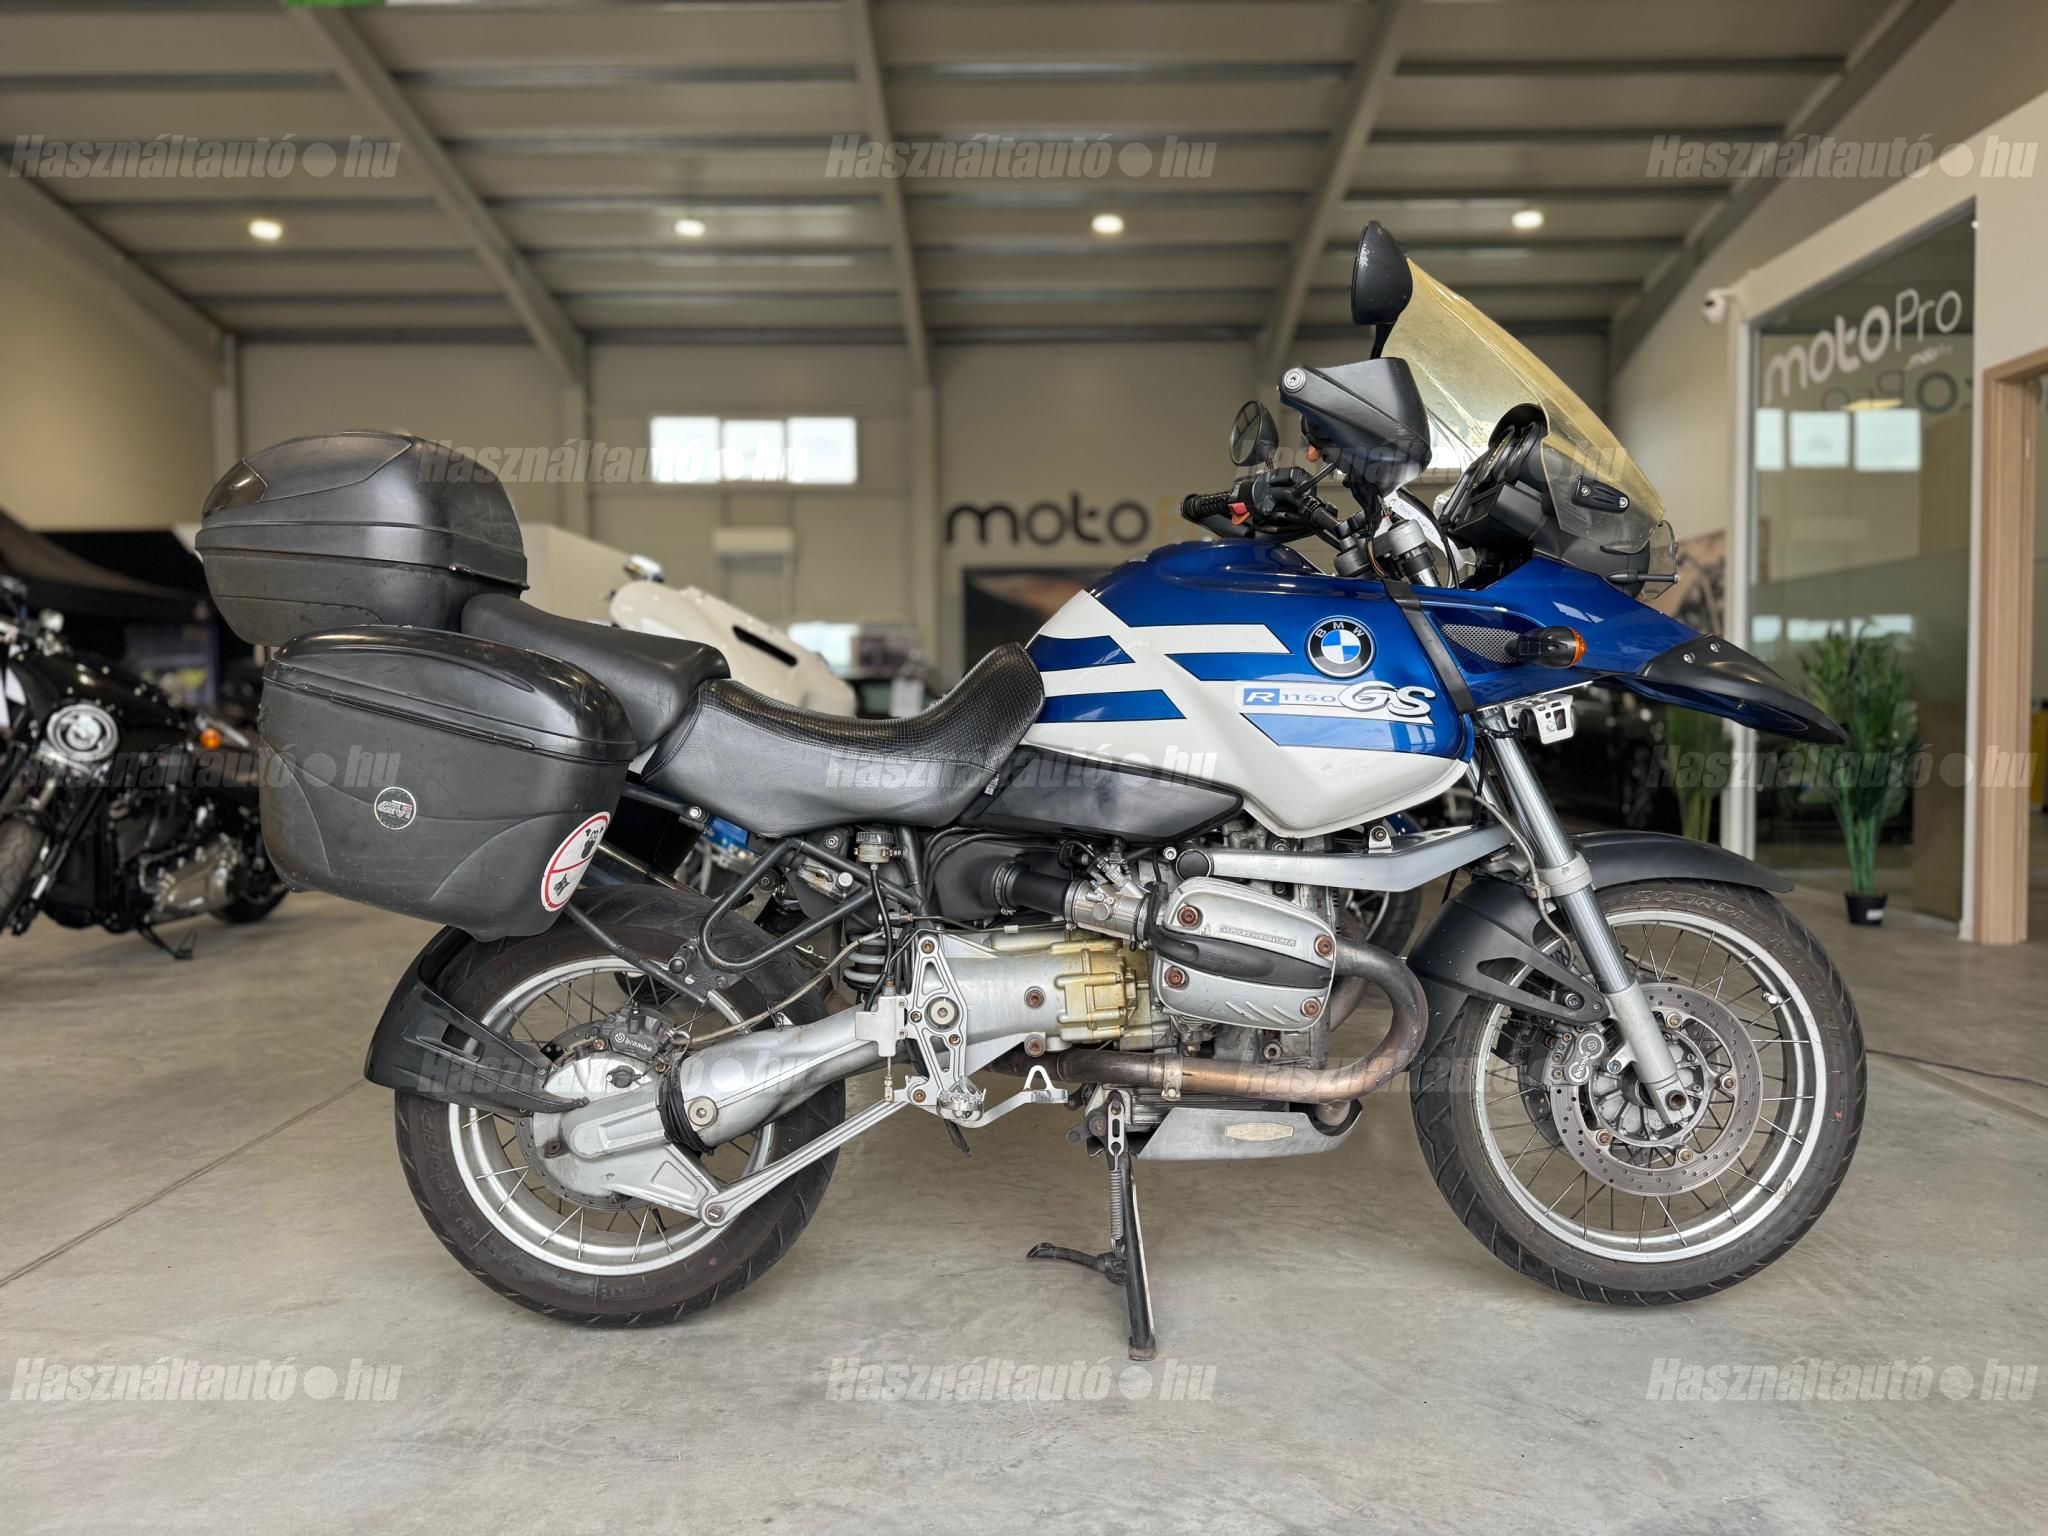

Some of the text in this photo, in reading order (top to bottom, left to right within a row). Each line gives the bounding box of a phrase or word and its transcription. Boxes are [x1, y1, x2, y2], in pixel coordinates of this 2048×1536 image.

[1764, 288, 1963, 404] motoPro
[1315, 621, 1366, 639] BMW
[625, 1036, 652, 1052] brembo
[1574, 1051, 1591, 1077] brembo
